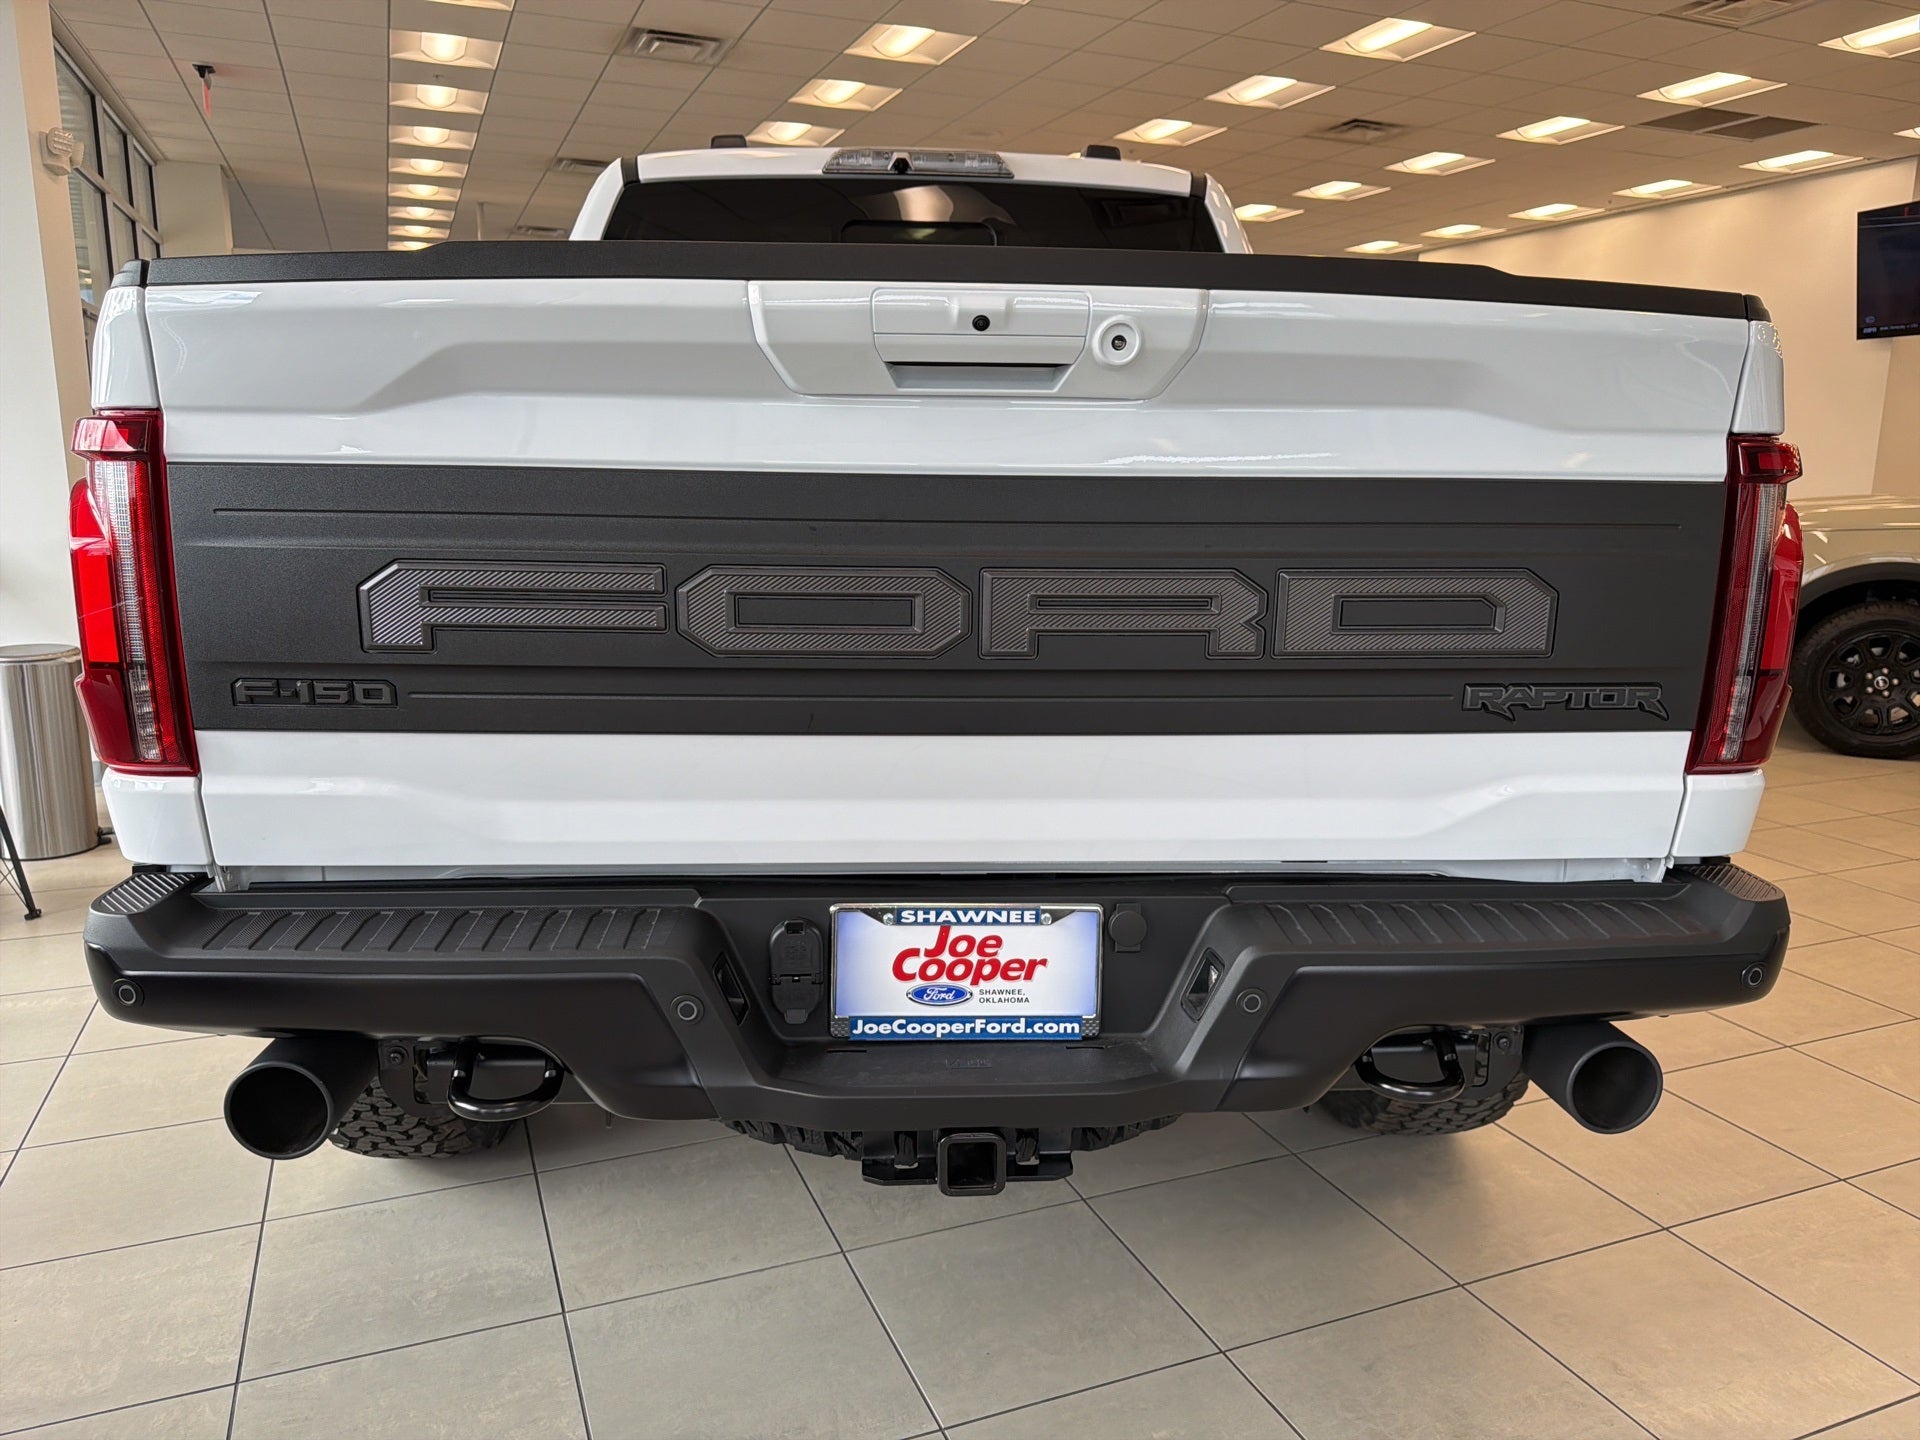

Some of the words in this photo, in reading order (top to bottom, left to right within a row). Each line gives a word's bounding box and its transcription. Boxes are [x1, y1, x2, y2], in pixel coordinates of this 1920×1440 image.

[358, 559, 1559, 660] FORD
[231, 678, 398, 707] F-150
[1462, 682, 1670, 721] RAPTOR
[900, 909, 1037, 924] SHAWNEE
[923, 925, 1004, 958] Joe
[892, 948, 1049, 986] Cooper
[923, 987, 955, 1001] Ford
[978, 988, 1026, 997] SHAWNEE,
[978, 996, 1030, 1004] OKLAHOMA
[852, 1018, 1081, 1038] JoeCooperFord.com
